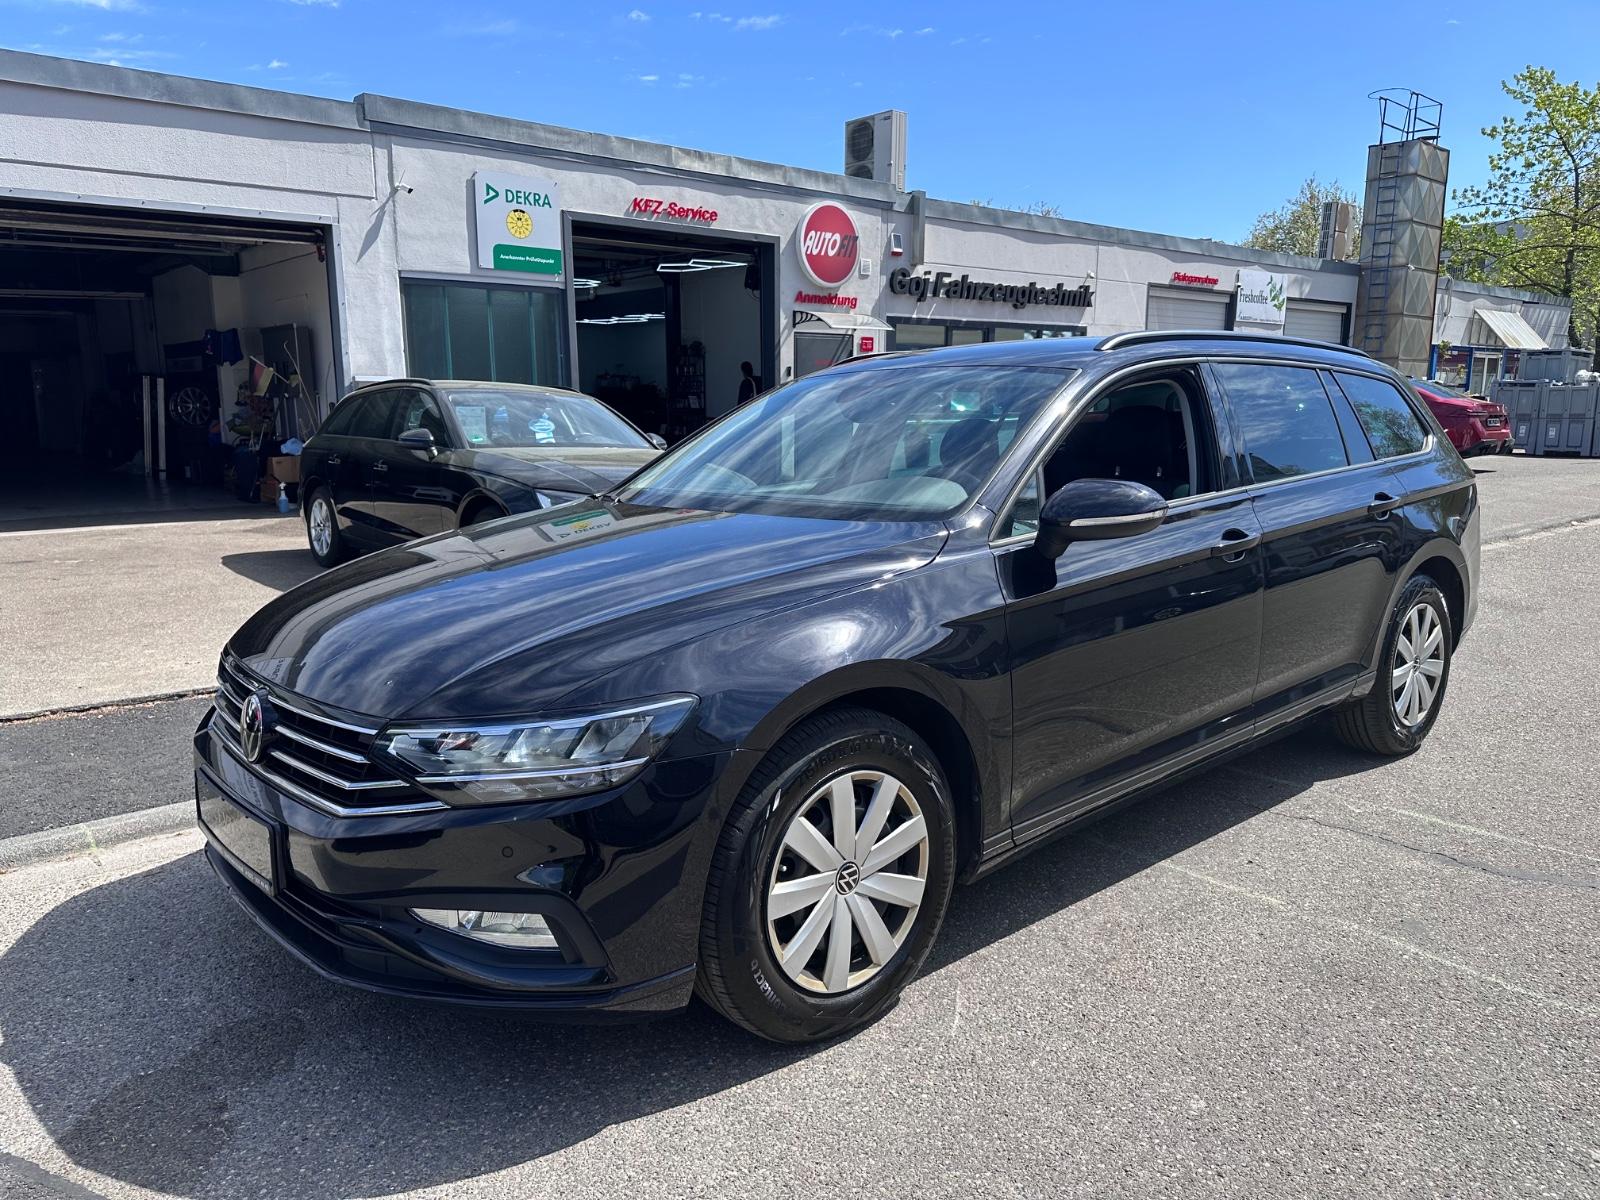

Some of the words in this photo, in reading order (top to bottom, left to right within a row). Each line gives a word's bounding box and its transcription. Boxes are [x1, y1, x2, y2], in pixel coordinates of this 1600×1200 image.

[504, 189, 552, 208] DEKRA
[630, 197, 718, 221] KFZ-Service
[890, 267, 931, 302] Goj
[933, 271, 1095, 309] Fahrzeugtechnik
[1239, 287, 1269, 305] Freshcoffee
[795, 290, 857, 309] Anmeldung
